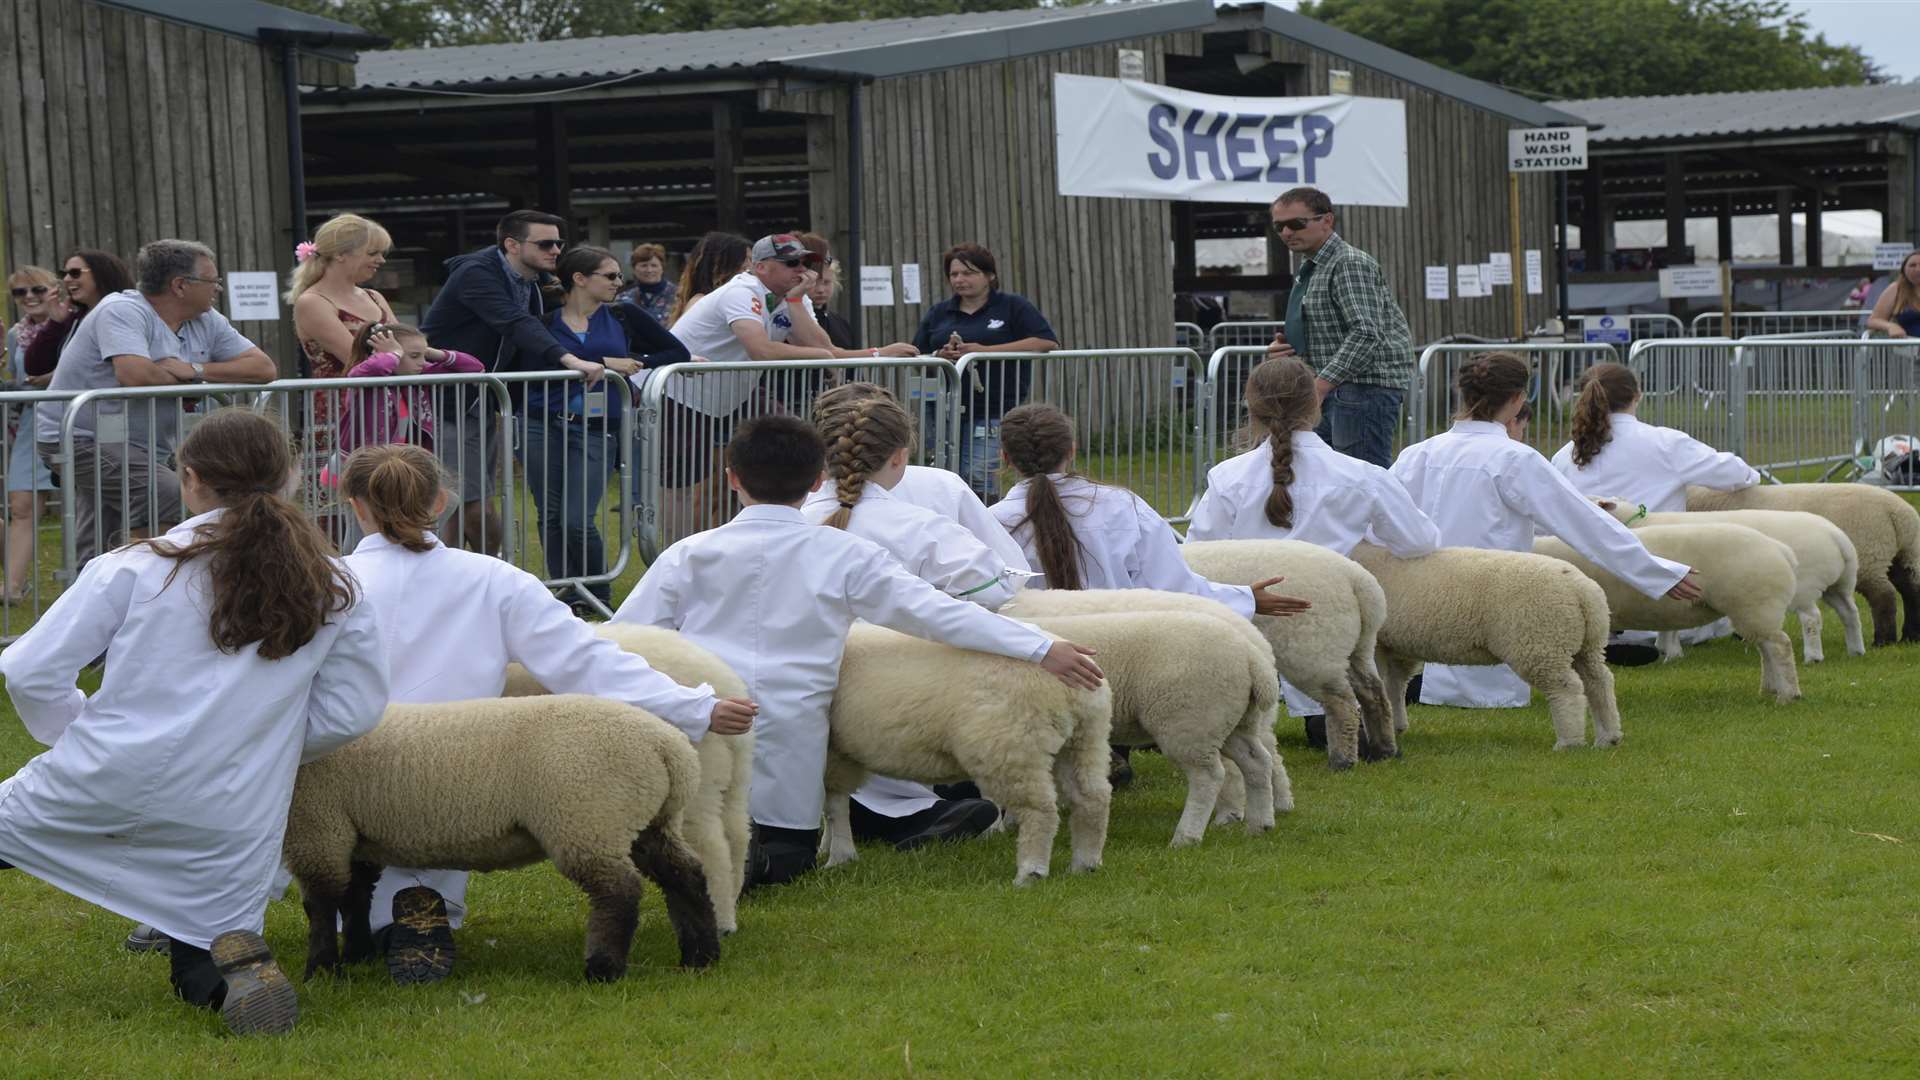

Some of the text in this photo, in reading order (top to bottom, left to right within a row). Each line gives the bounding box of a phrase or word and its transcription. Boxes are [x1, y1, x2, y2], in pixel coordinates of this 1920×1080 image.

[1524, 131, 1570, 142] HAND
[1147, 104, 1335, 184] SHEEP
[1524, 144, 1571, 155] WASH
[1514, 156, 1582, 168] STATION
[752, 297, 762, 316] 3
